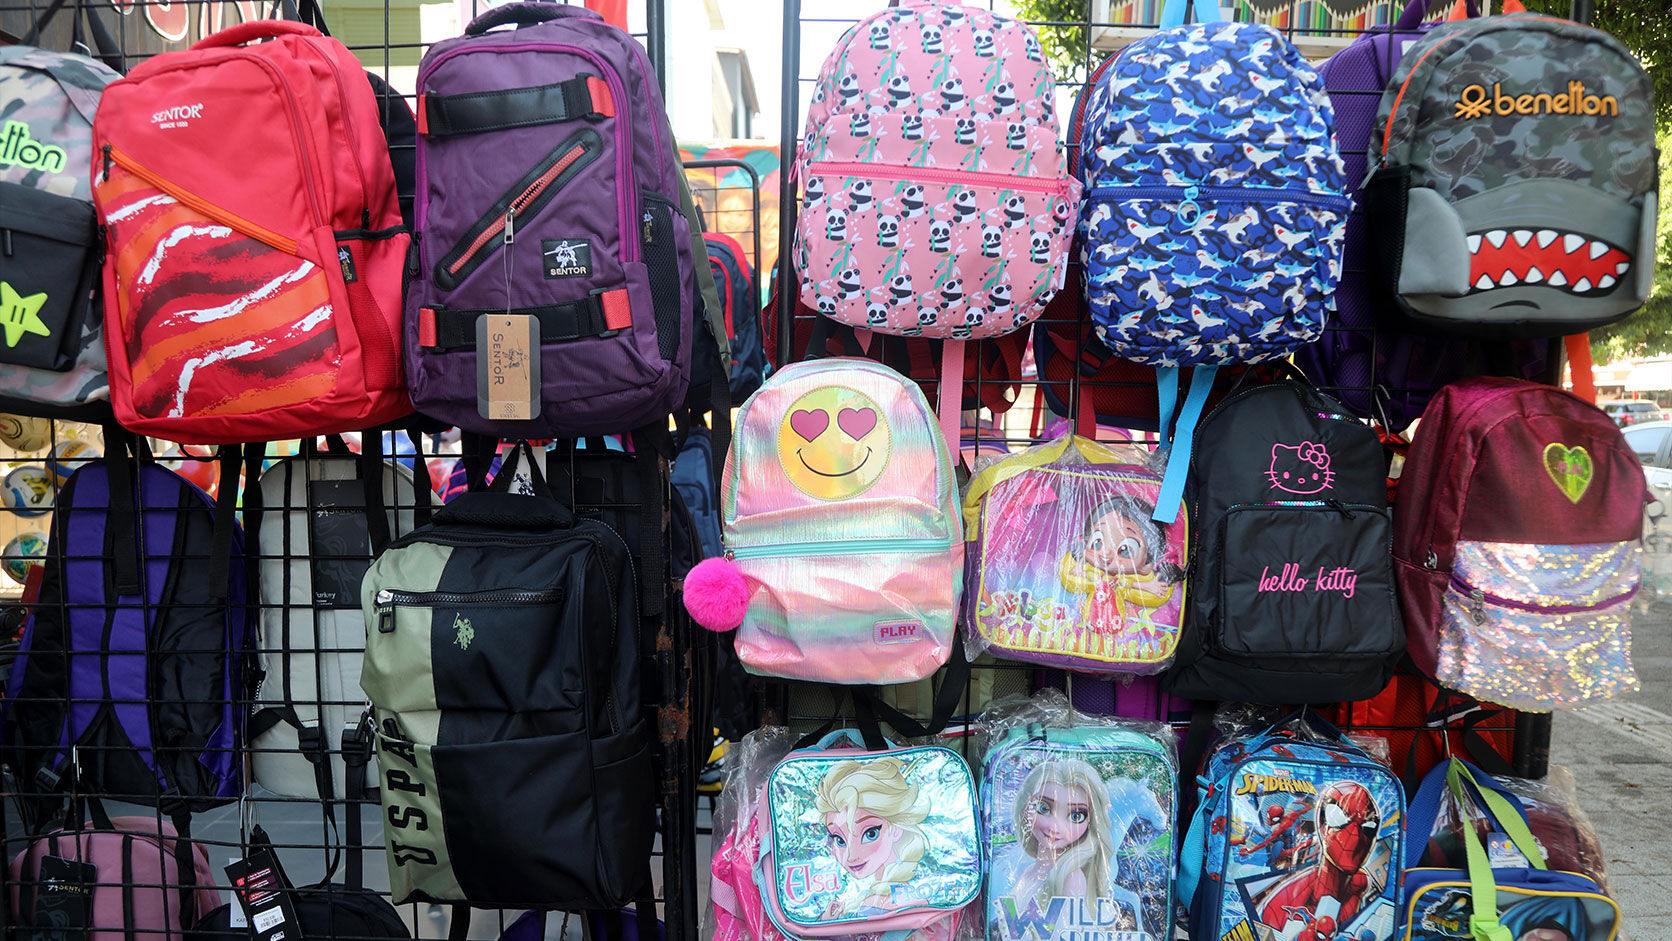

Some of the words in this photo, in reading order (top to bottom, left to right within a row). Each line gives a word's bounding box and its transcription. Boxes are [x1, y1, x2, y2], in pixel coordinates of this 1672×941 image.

[1493, 80, 1619, 118] benetton
[0, 121, 66, 173] tton
[550, 266, 588, 276] SENTOR
[492, 332, 505, 386] SENTOR
[1258, 563, 1309, 593] hello
[1315, 566, 1358, 599] kitty
[880, 625, 917, 638] PLAY
[784, 863, 842, 904] Elsa
[889, 877, 974, 904] FROZEN
[998, 896, 1120, 940] WILD
